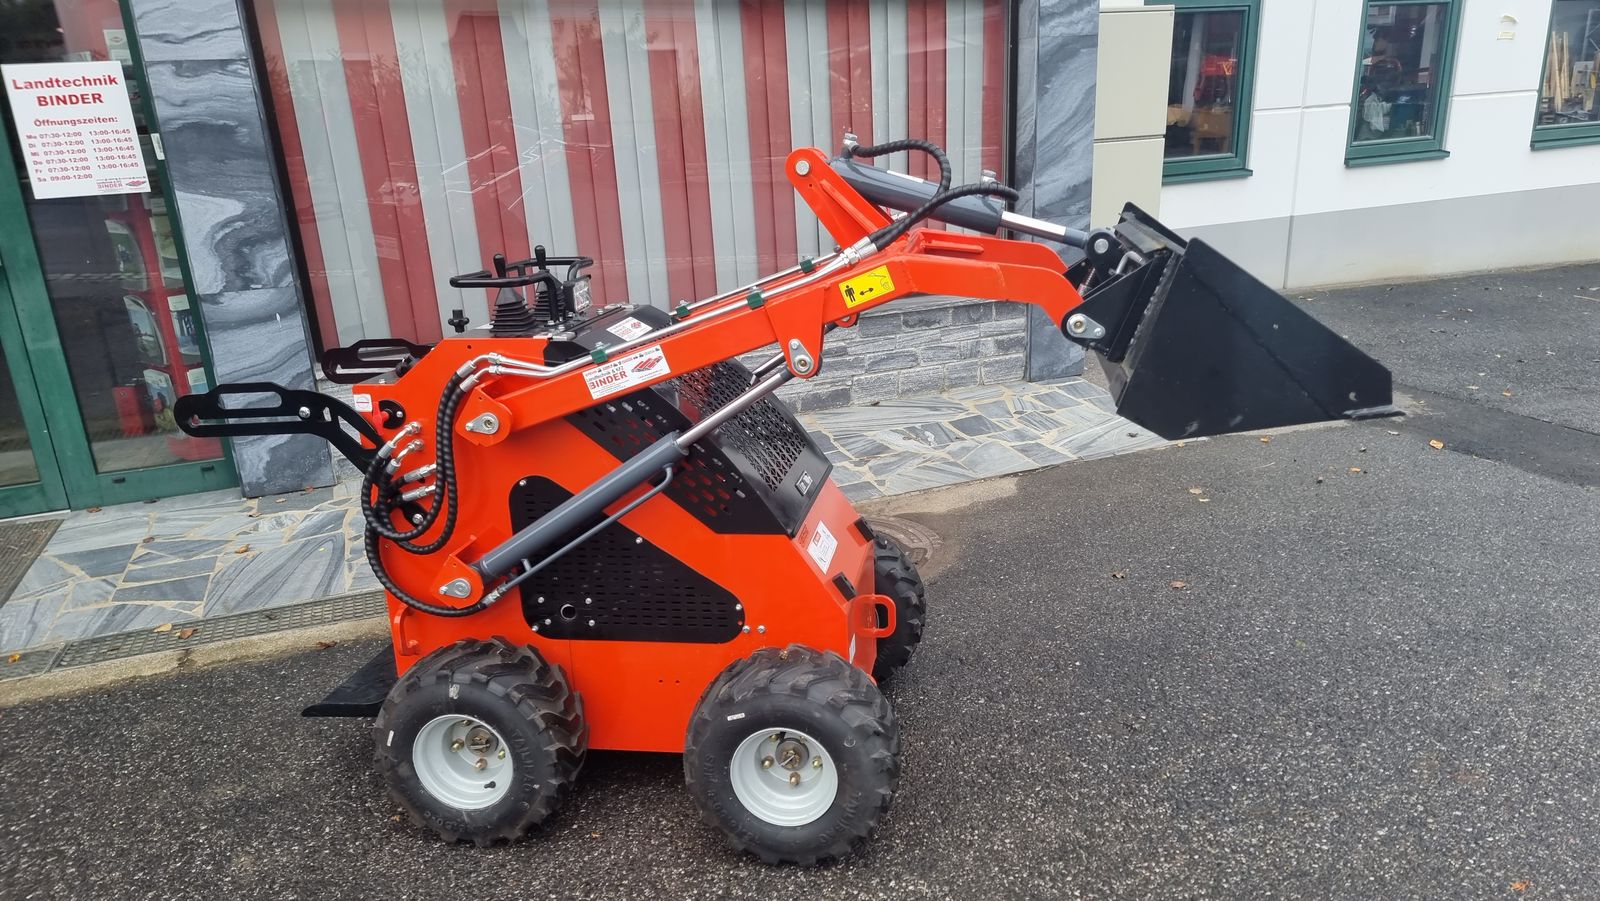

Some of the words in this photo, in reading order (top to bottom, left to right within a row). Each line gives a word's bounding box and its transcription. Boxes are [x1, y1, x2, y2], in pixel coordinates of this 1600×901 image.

[12, 75, 118, 90] Landtechnik
[36, 93, 104, 107] BINDER
[34, 116, 118, 127] Öffnungszeiten:
[93, 145, 135, 153] 13:00-16:45
[589, 370, 628, 390] BINDER
